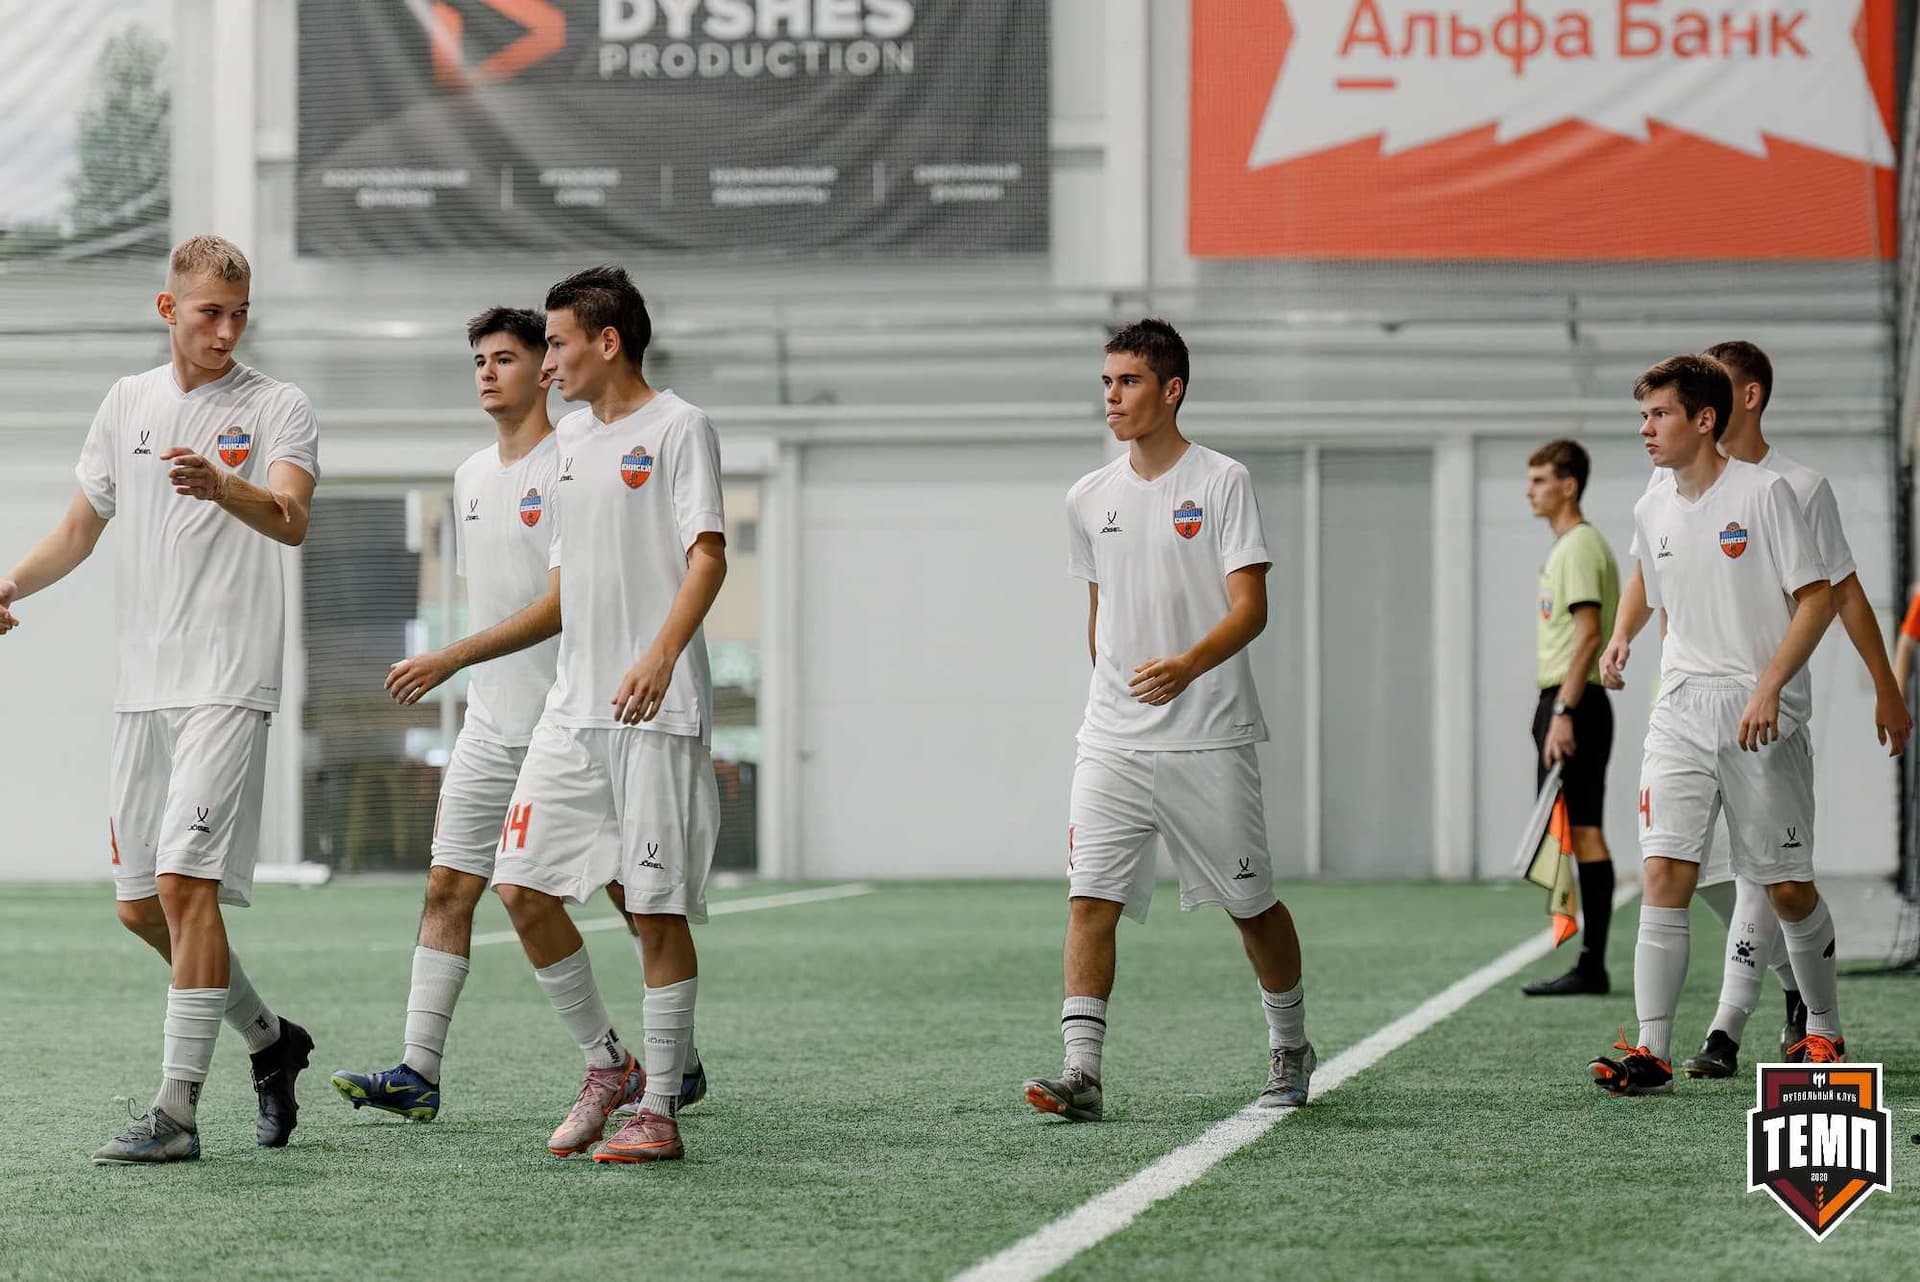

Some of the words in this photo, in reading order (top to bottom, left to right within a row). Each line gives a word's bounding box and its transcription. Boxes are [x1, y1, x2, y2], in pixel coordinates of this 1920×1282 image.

[600, 0, 915, 40] DYSHES
[1339, 0, 1595, 77] Альфа
[1616, 0, 1812, 58] Банк
[600, 40, 914, 80] PRODUCTION
